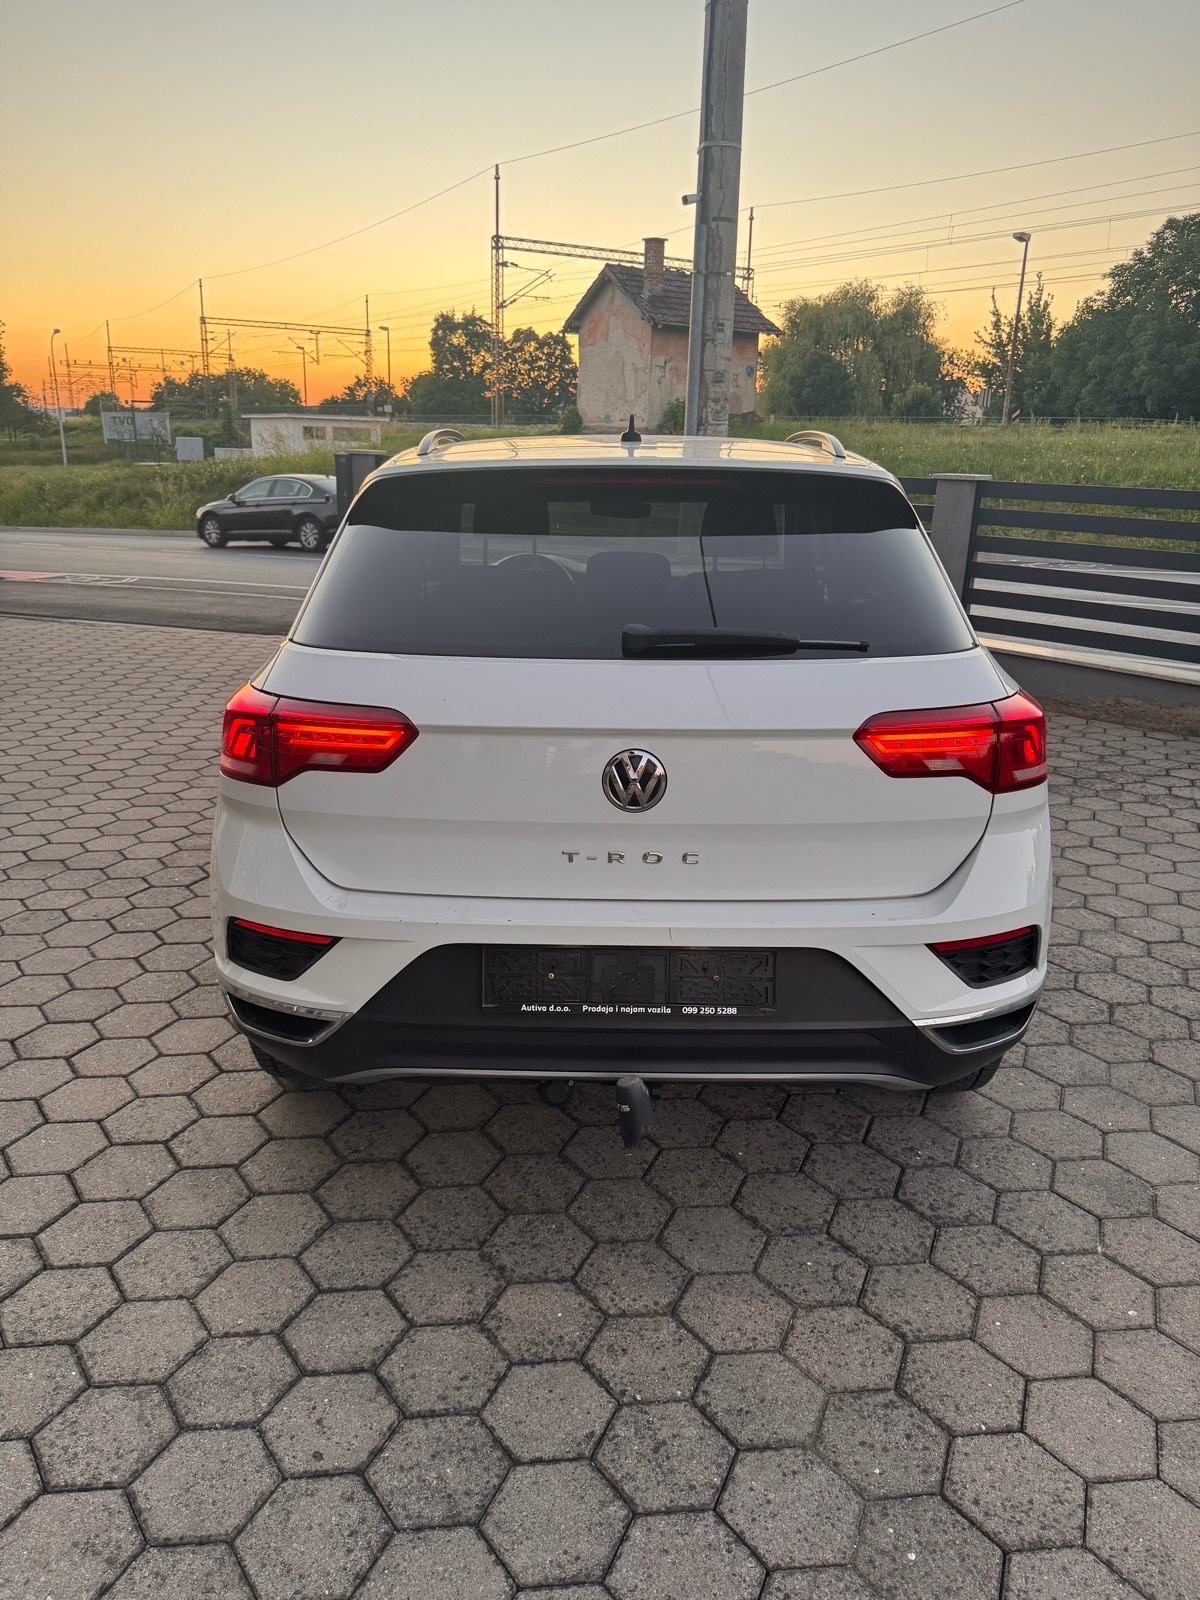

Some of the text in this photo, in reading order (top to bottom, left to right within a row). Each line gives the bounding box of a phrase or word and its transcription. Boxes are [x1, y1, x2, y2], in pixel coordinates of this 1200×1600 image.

[602, 748, 667, 813] VW
[562, 850, 700, 865] T-ROC
[521, 1004, 547, 1012] Autiva
[549, 1004, 571, 1012] d.o.o.
[583, 1004, 613, 1014] Prodaja
[620, 1006, 646, 1014] najam
[647, 1006, 671, 1014] vozila
[682, 1006, 698, 1014] 099
[699, 1006, 715, 1014] 250
